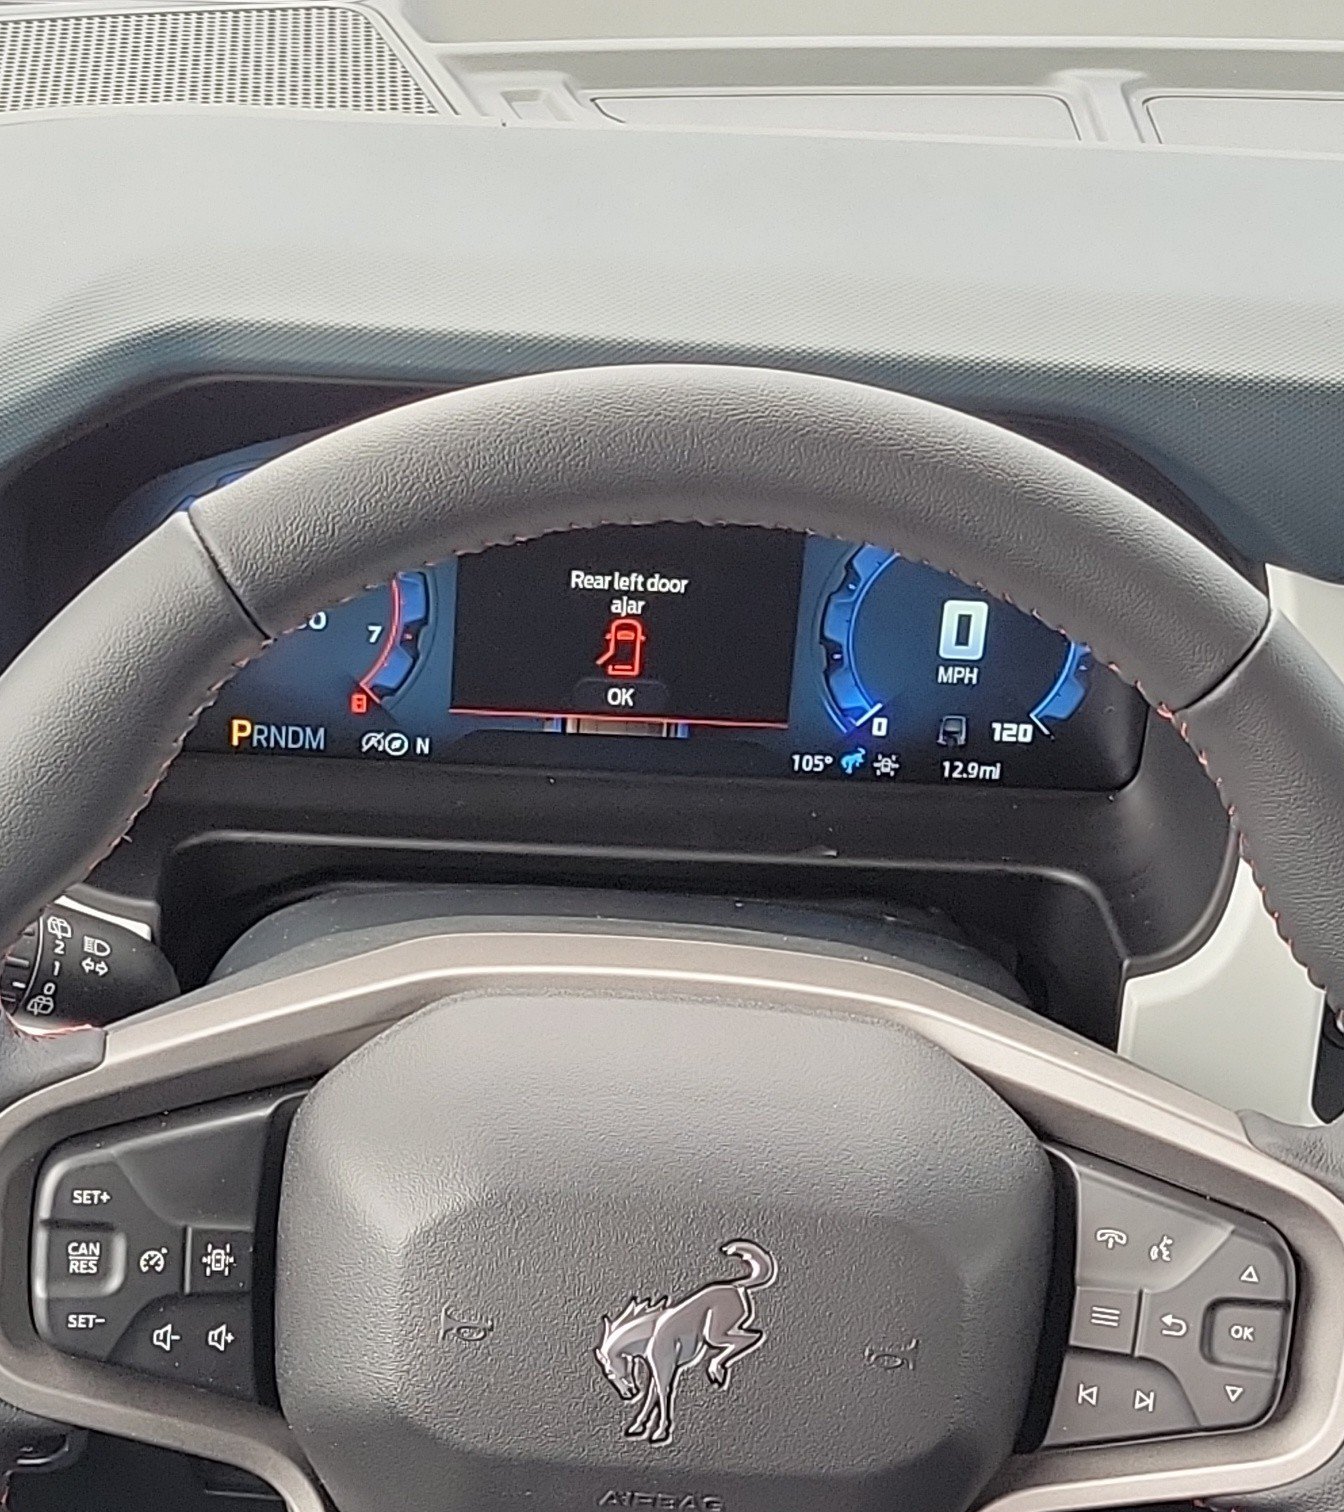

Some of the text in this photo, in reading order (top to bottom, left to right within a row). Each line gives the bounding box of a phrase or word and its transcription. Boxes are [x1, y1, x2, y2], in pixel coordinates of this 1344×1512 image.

[570, 570, 689, 594] Rear left door
[610, 596, 646, 617] ajar
[367, 625, 382, 643] 7
[938, 600, 989, 661] 0
[937, 666, 979, 685] MPH
[607, 687, 635, 707] OK
[231, 719, 326, 750] PRNDM
[871, 717, 888, 737] 0
[992, 722, 1034, 743] 120
[416, 737, 430, 754] N
[791, 754, 834, 772] 105°
[53, 939, 65, 955] 2
[53, 960, 61, 977] 1
[43, 982, 56, 996] 0
[72, 1190, 111, 1204] SET+
[67, 1242, 101, 1257] CAN
[68, 1260, 98, 1275] RES
[1230, 1325, 1255, 1342] OK
[598, 1490, 725, 1512] AIRBAG
